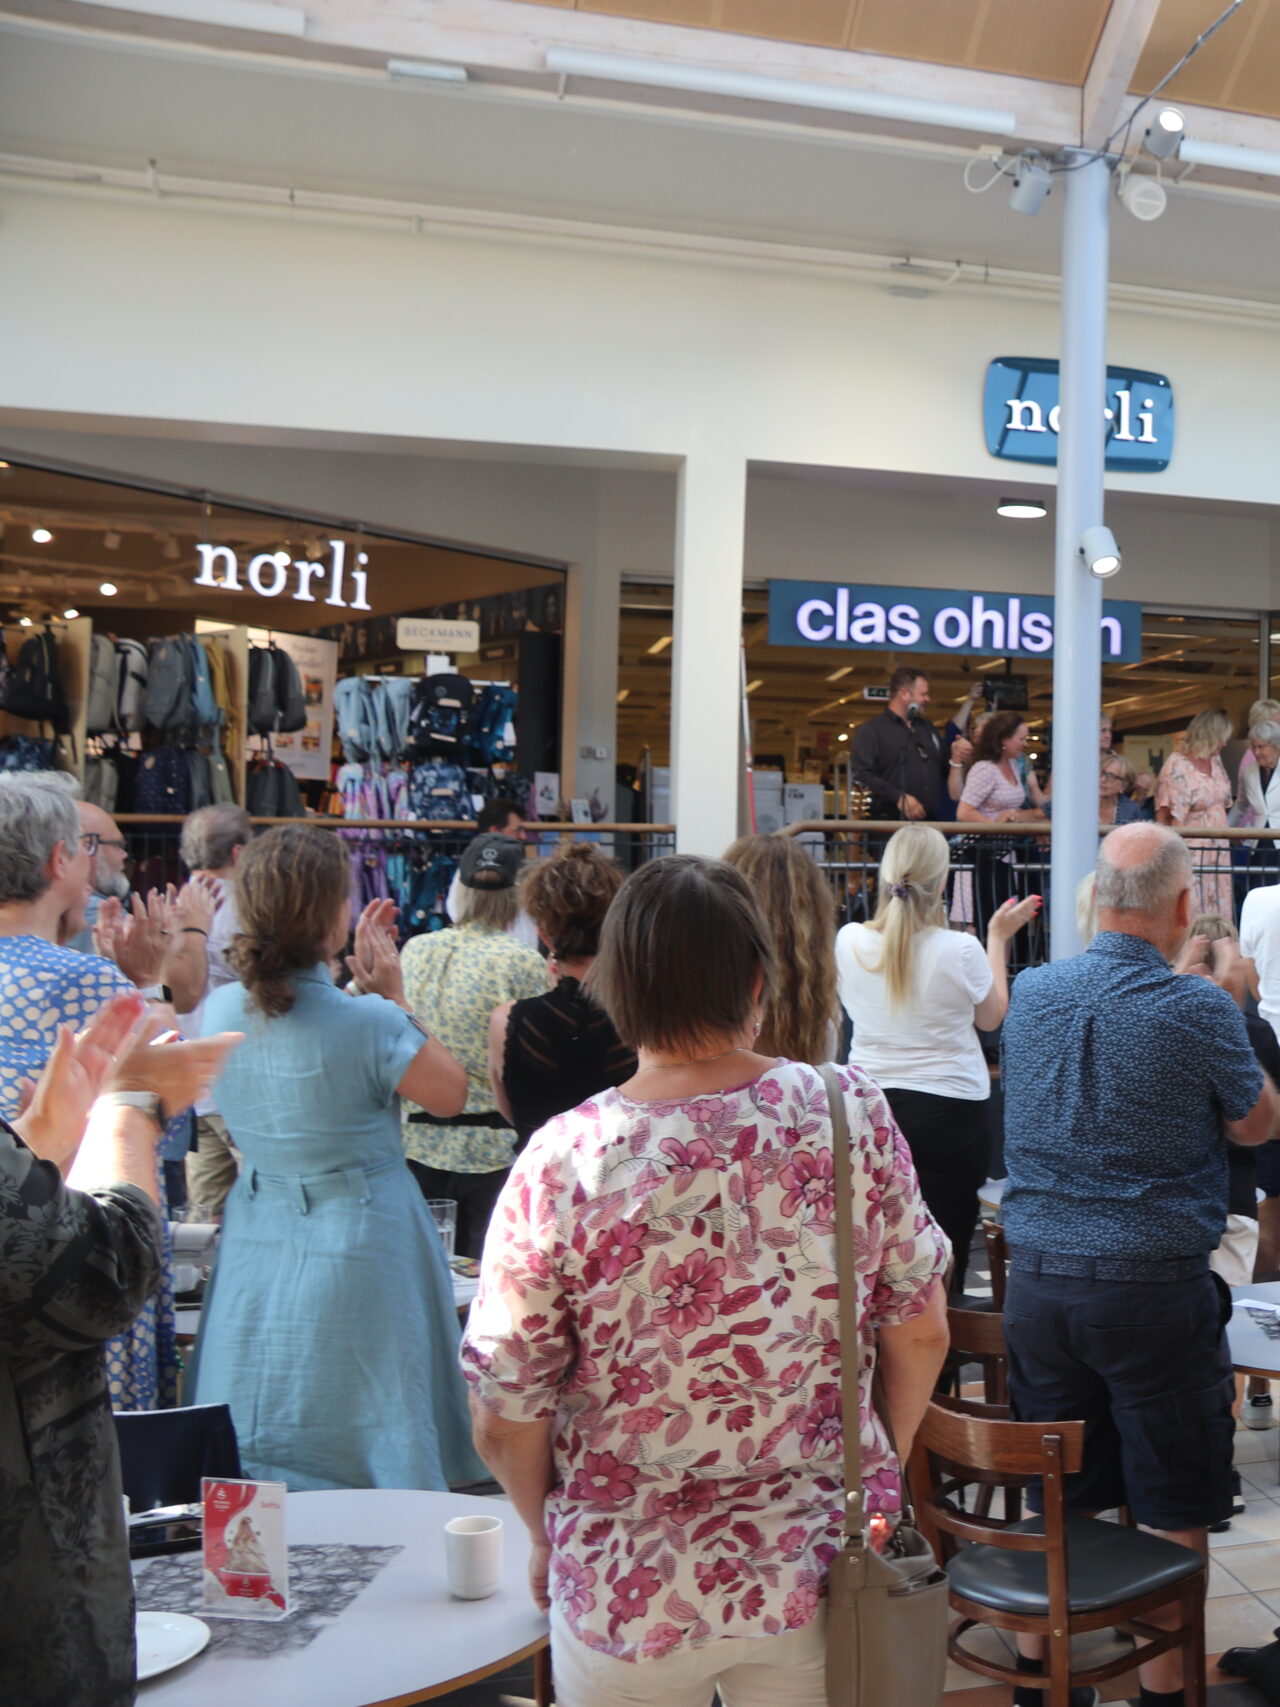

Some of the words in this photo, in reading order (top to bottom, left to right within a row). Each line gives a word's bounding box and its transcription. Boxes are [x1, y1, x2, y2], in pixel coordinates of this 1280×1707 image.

[1006, 391, 1158, 443] nli
[194, 540, 371, 611] norli
[404, 626, 473, 639] BECKMANN
[796, 587, 922, 645] clas
[933, 595, 1122, 656] ohlsn
